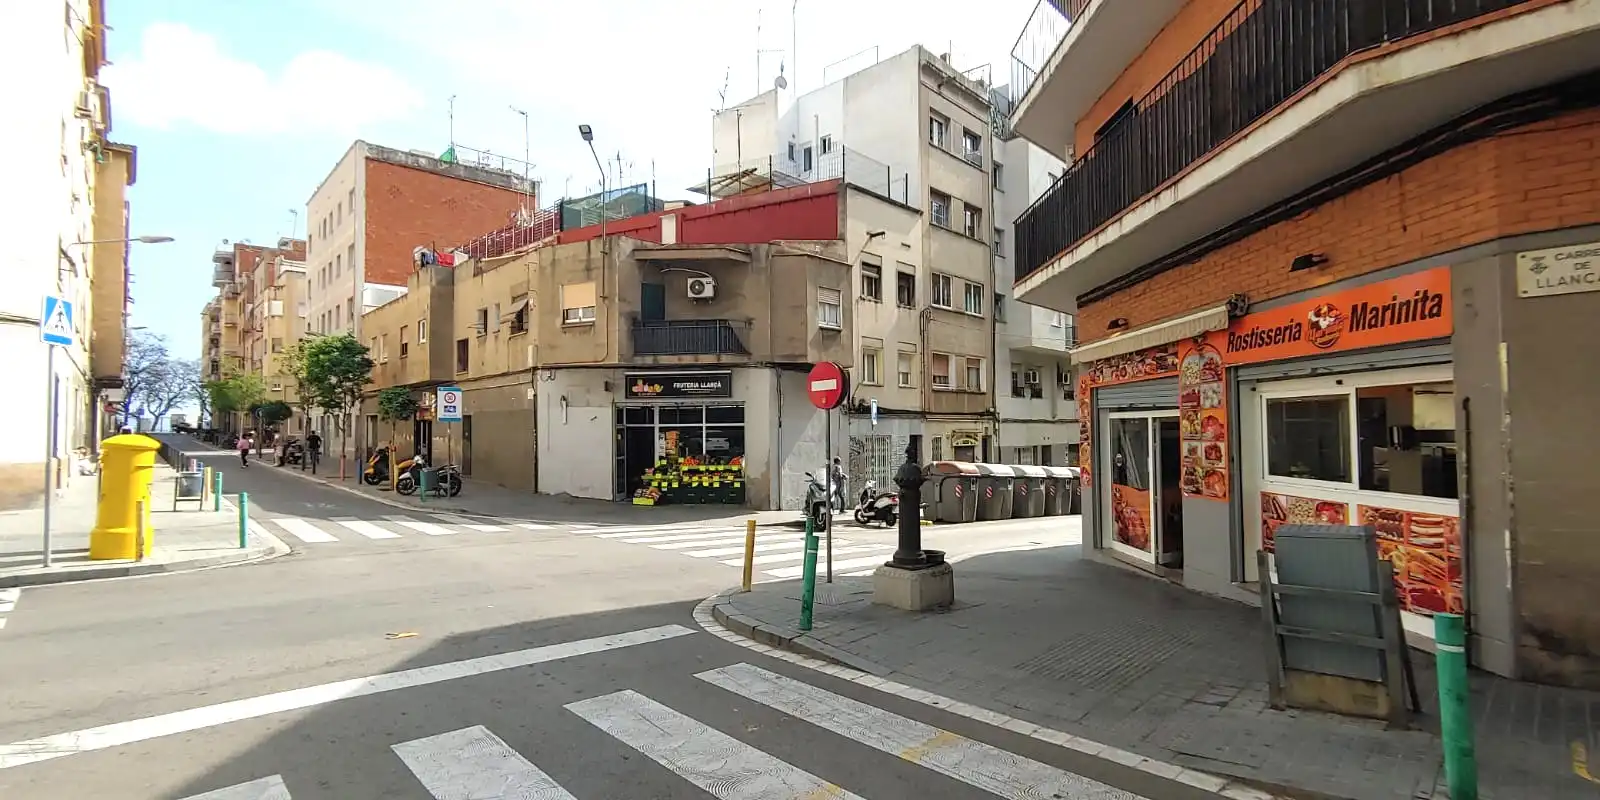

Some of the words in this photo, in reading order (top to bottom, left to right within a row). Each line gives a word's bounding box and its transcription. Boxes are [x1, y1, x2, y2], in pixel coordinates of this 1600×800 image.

[1574, 261, 1591, 270] DE
[1536, 272, 1600, 288] LLANÇ
[1226, 318, 1303, 353] Rostisseria
[1349, 289, 1443, 333] Marinita
